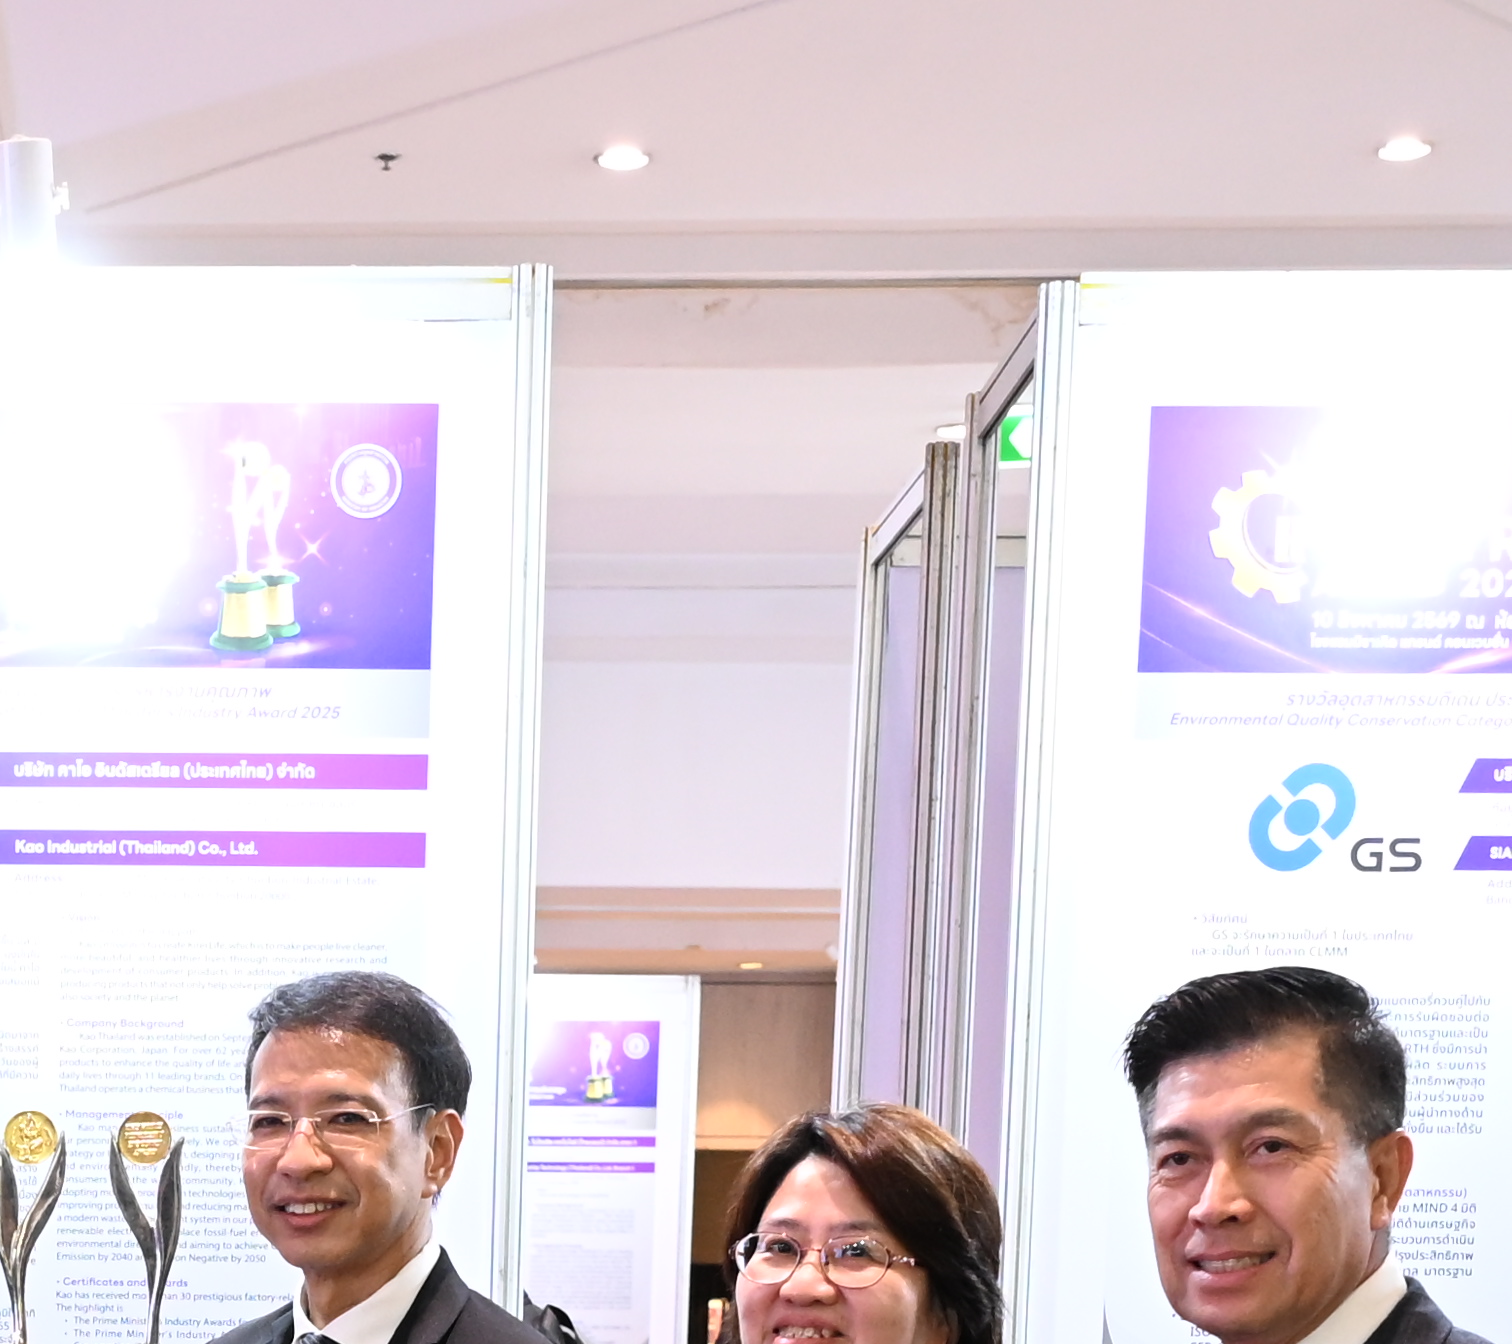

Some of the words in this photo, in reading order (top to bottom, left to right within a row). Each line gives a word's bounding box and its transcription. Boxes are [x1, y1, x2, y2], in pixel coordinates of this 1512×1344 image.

[246, 704, 296, 720] Award
[300, 705, 340, 720] 2025
[1170, 712, 1283, 728] Environmental
[1287, 712, 1344, 733] Quality
[1348, 712, 1451, 728] Conservation
[15, 839, 45, 853] Kao
[47, 840, 116, 854] Industrial
[119, 840, 195, 856] (Thailand)
[198, 841, 227, 856] Co.,
[230, 841, 258, 855] Ltd.
[1350, 837, 1423, 873] GS
[67, 1018, 117, 1029] Company
[121, 1019, 183, 1030] Background
[1412, 1202, 1448, 1213] MIND
[1450, 1202, 1458, 1213] 4
[57, 1252, 95, 1260] Emission
[98, 1253, 108, 1262] by
[111, 1253, 136, 1261] 2040
[189, 1254, 228, 1264] Negative
[231, 1254, 241, 1264] by
[245, 1254, 266, 1262] 2050
[63, 1277, 124, 1286] Certificates
